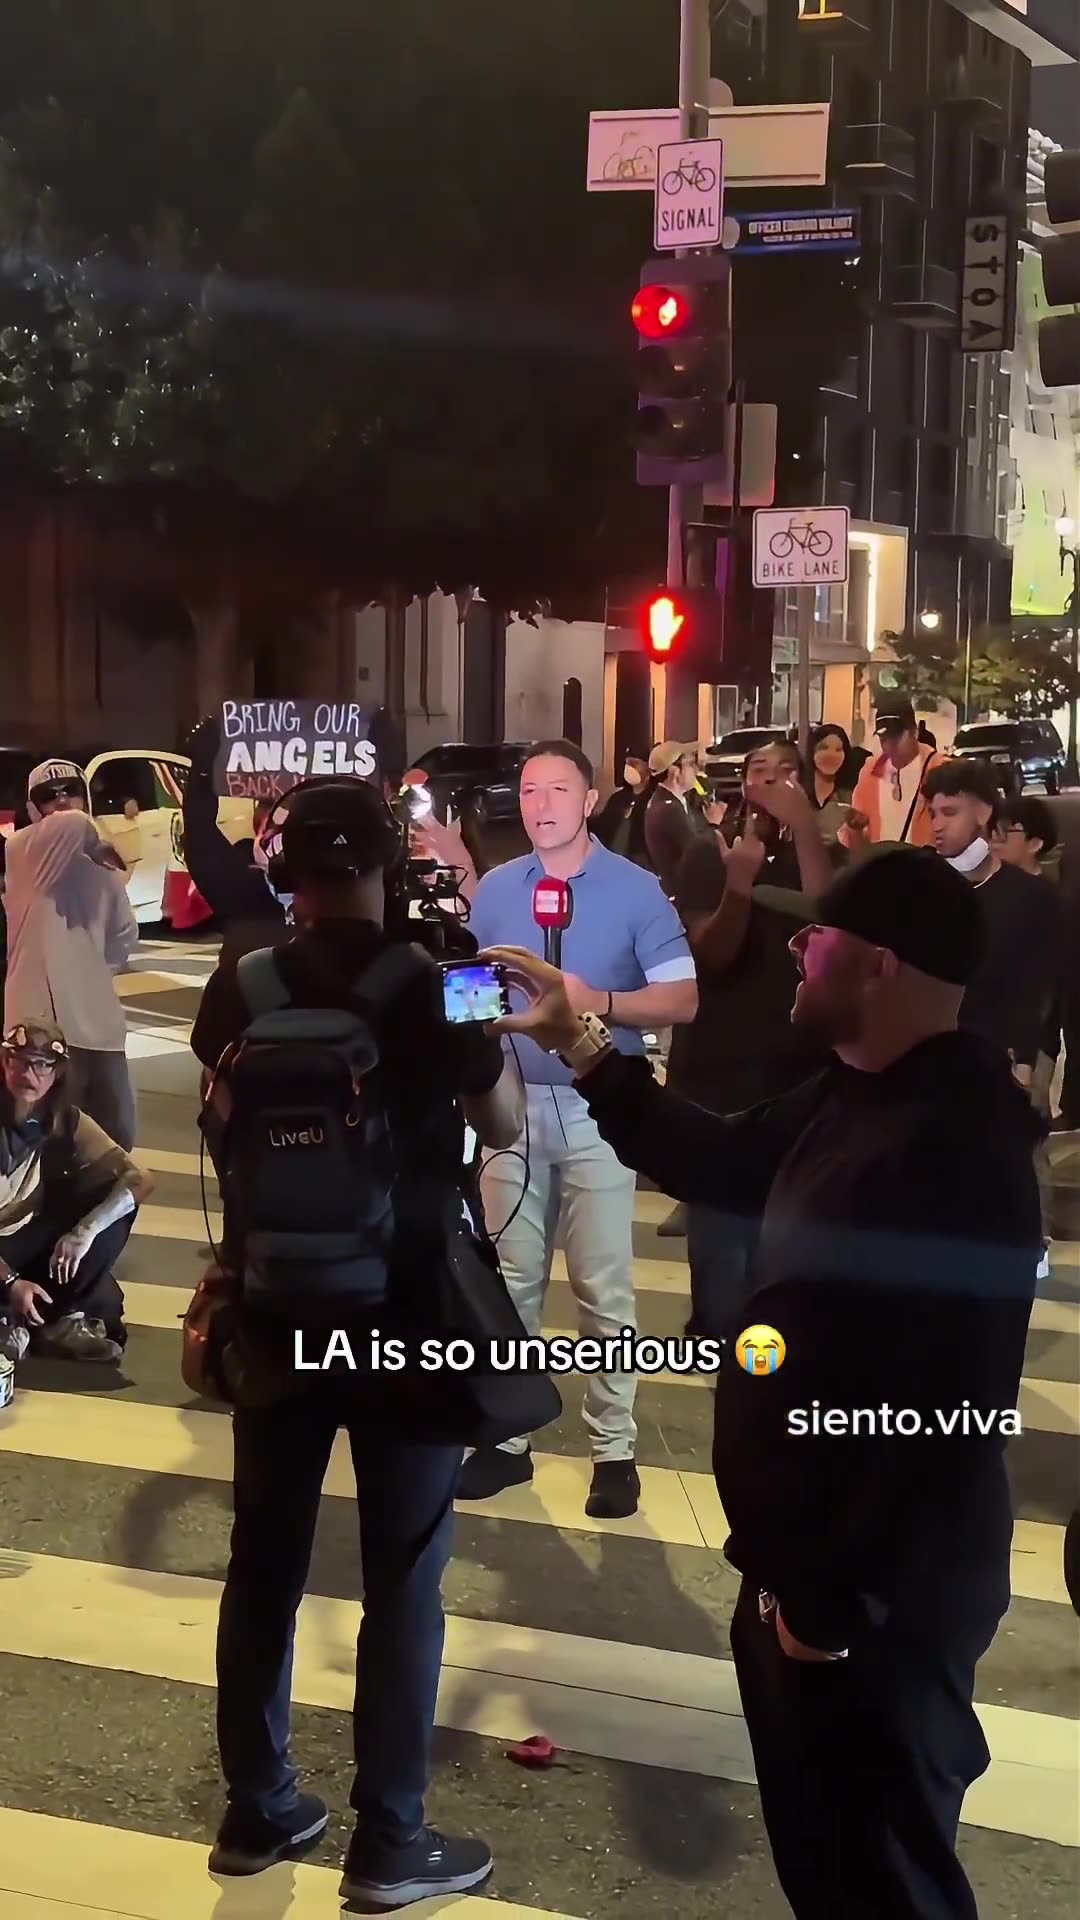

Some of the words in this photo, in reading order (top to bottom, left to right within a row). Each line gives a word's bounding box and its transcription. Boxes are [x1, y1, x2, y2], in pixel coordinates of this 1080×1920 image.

[661, 206, 715, 232] SIGNAL
[762, 562, 795, 578] BIKE
[804, 560, 840, 576] LANE
[223, 701, 300, 737] BRING
[314, 703, 361, 737] OUR
[226, 737, 377, 776] ANGELS
[226, 773, 284, 798] BACK
